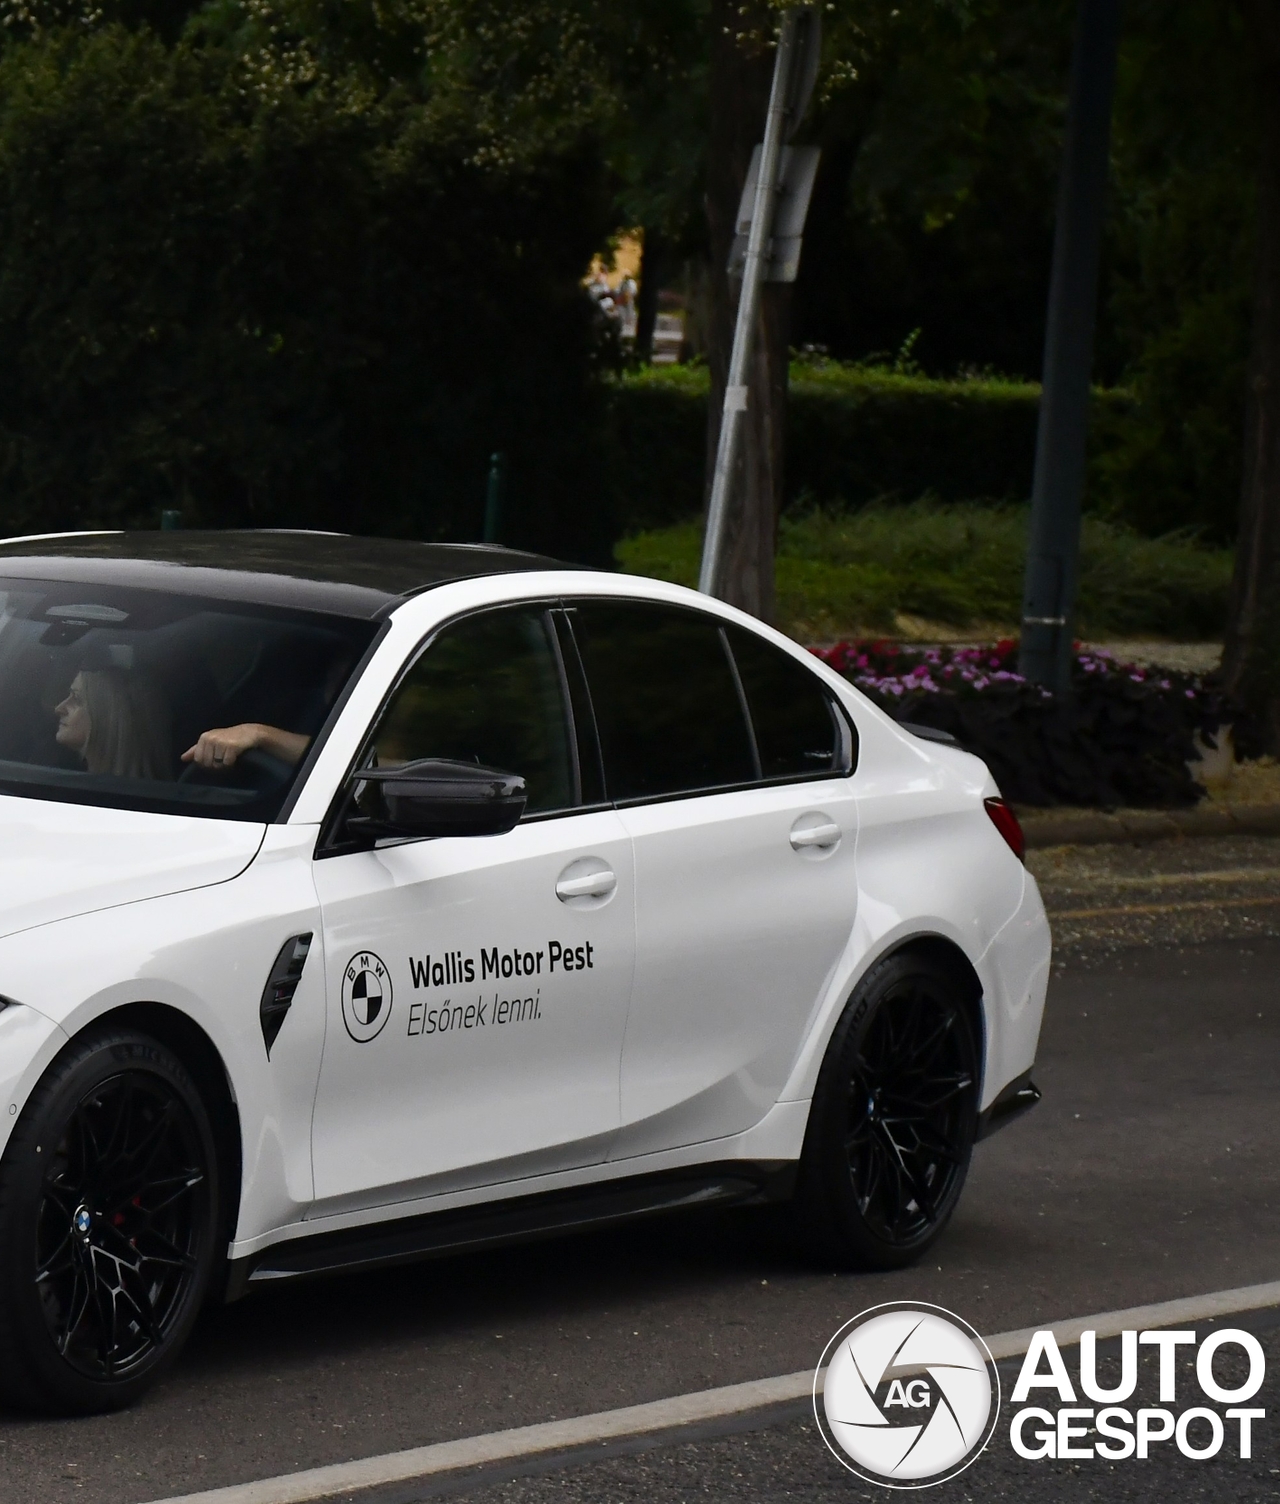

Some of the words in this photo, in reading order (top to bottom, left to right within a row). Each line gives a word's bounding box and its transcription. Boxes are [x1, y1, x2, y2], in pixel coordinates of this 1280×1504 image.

[347, 956, 385, 982] BMW
[409, 951, 475, 989] Wallis
[480, 947, 544, 980] Motor
[548, 940, 594, 973] Pest
[407, 995, 487, 1036] Elsőnek
[492, 988, 542, 1025] lenni.
